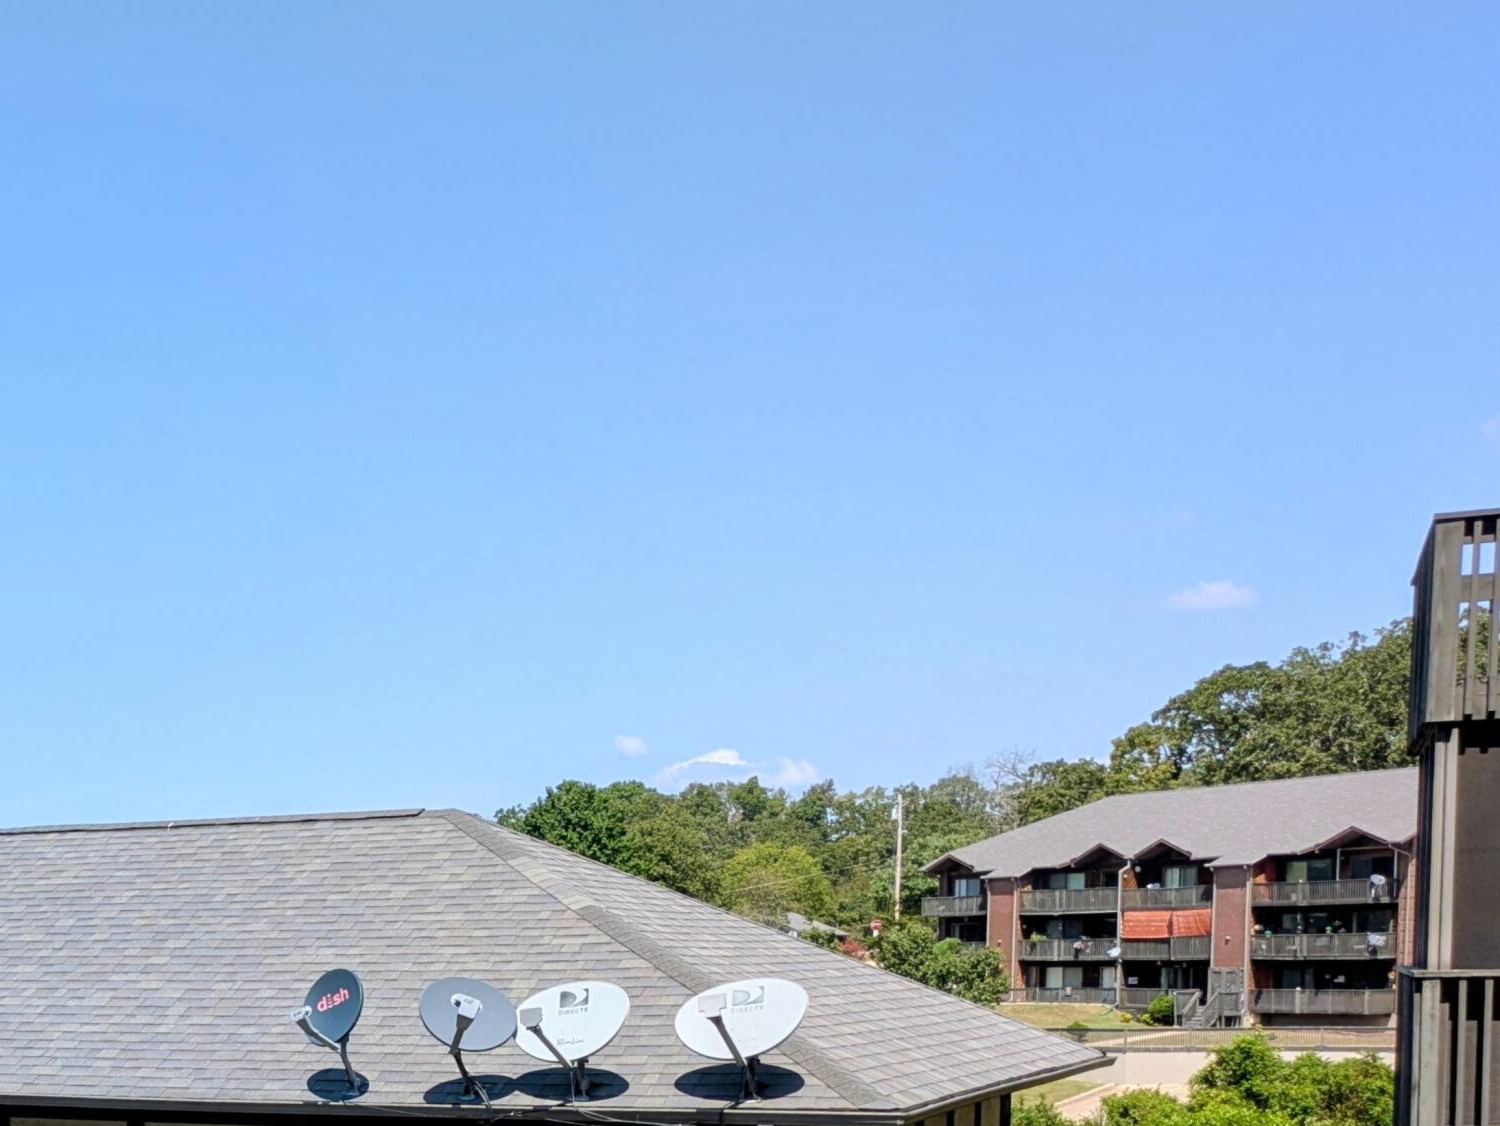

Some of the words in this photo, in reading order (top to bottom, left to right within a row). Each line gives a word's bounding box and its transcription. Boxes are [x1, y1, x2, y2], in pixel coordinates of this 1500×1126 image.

[317, 988, 349, 1012] dish
[559, 1007, 588, 1016] DIRECTV
[730, 1005, 764, 1014] DIRECTV
